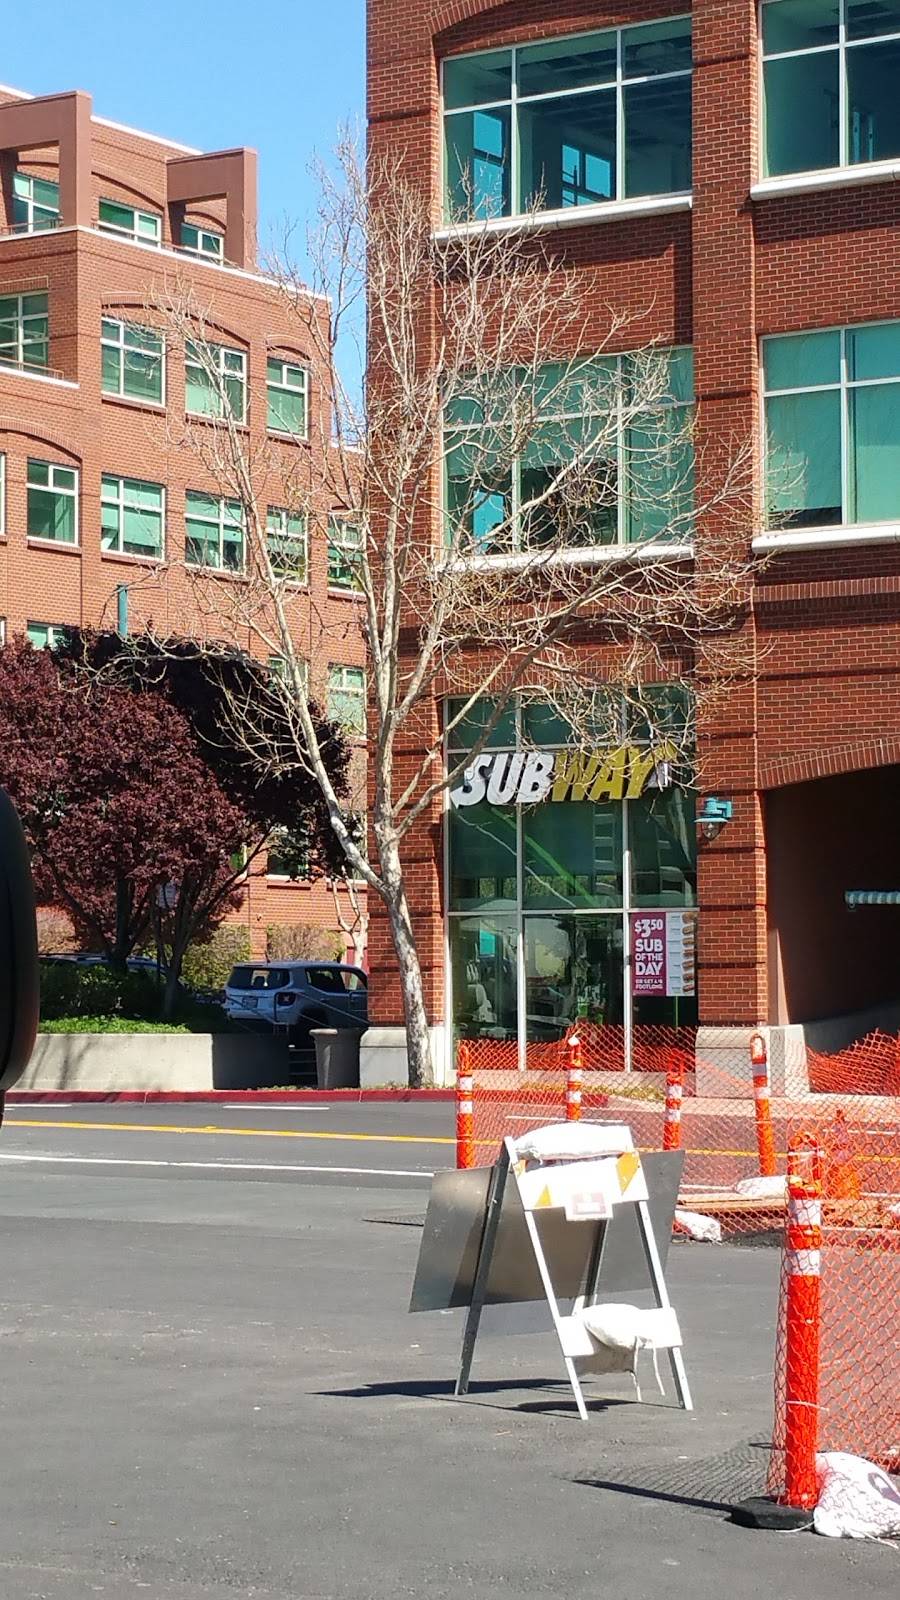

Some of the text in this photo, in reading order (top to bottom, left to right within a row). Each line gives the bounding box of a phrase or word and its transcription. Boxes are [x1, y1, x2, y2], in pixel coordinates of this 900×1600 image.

[450, 742, 677, 808] SUBWAY
[635, 939, 663, 952] SUB
[635, 953, 663, 961] OF THE
[635, 962, 663, 976] DAY
